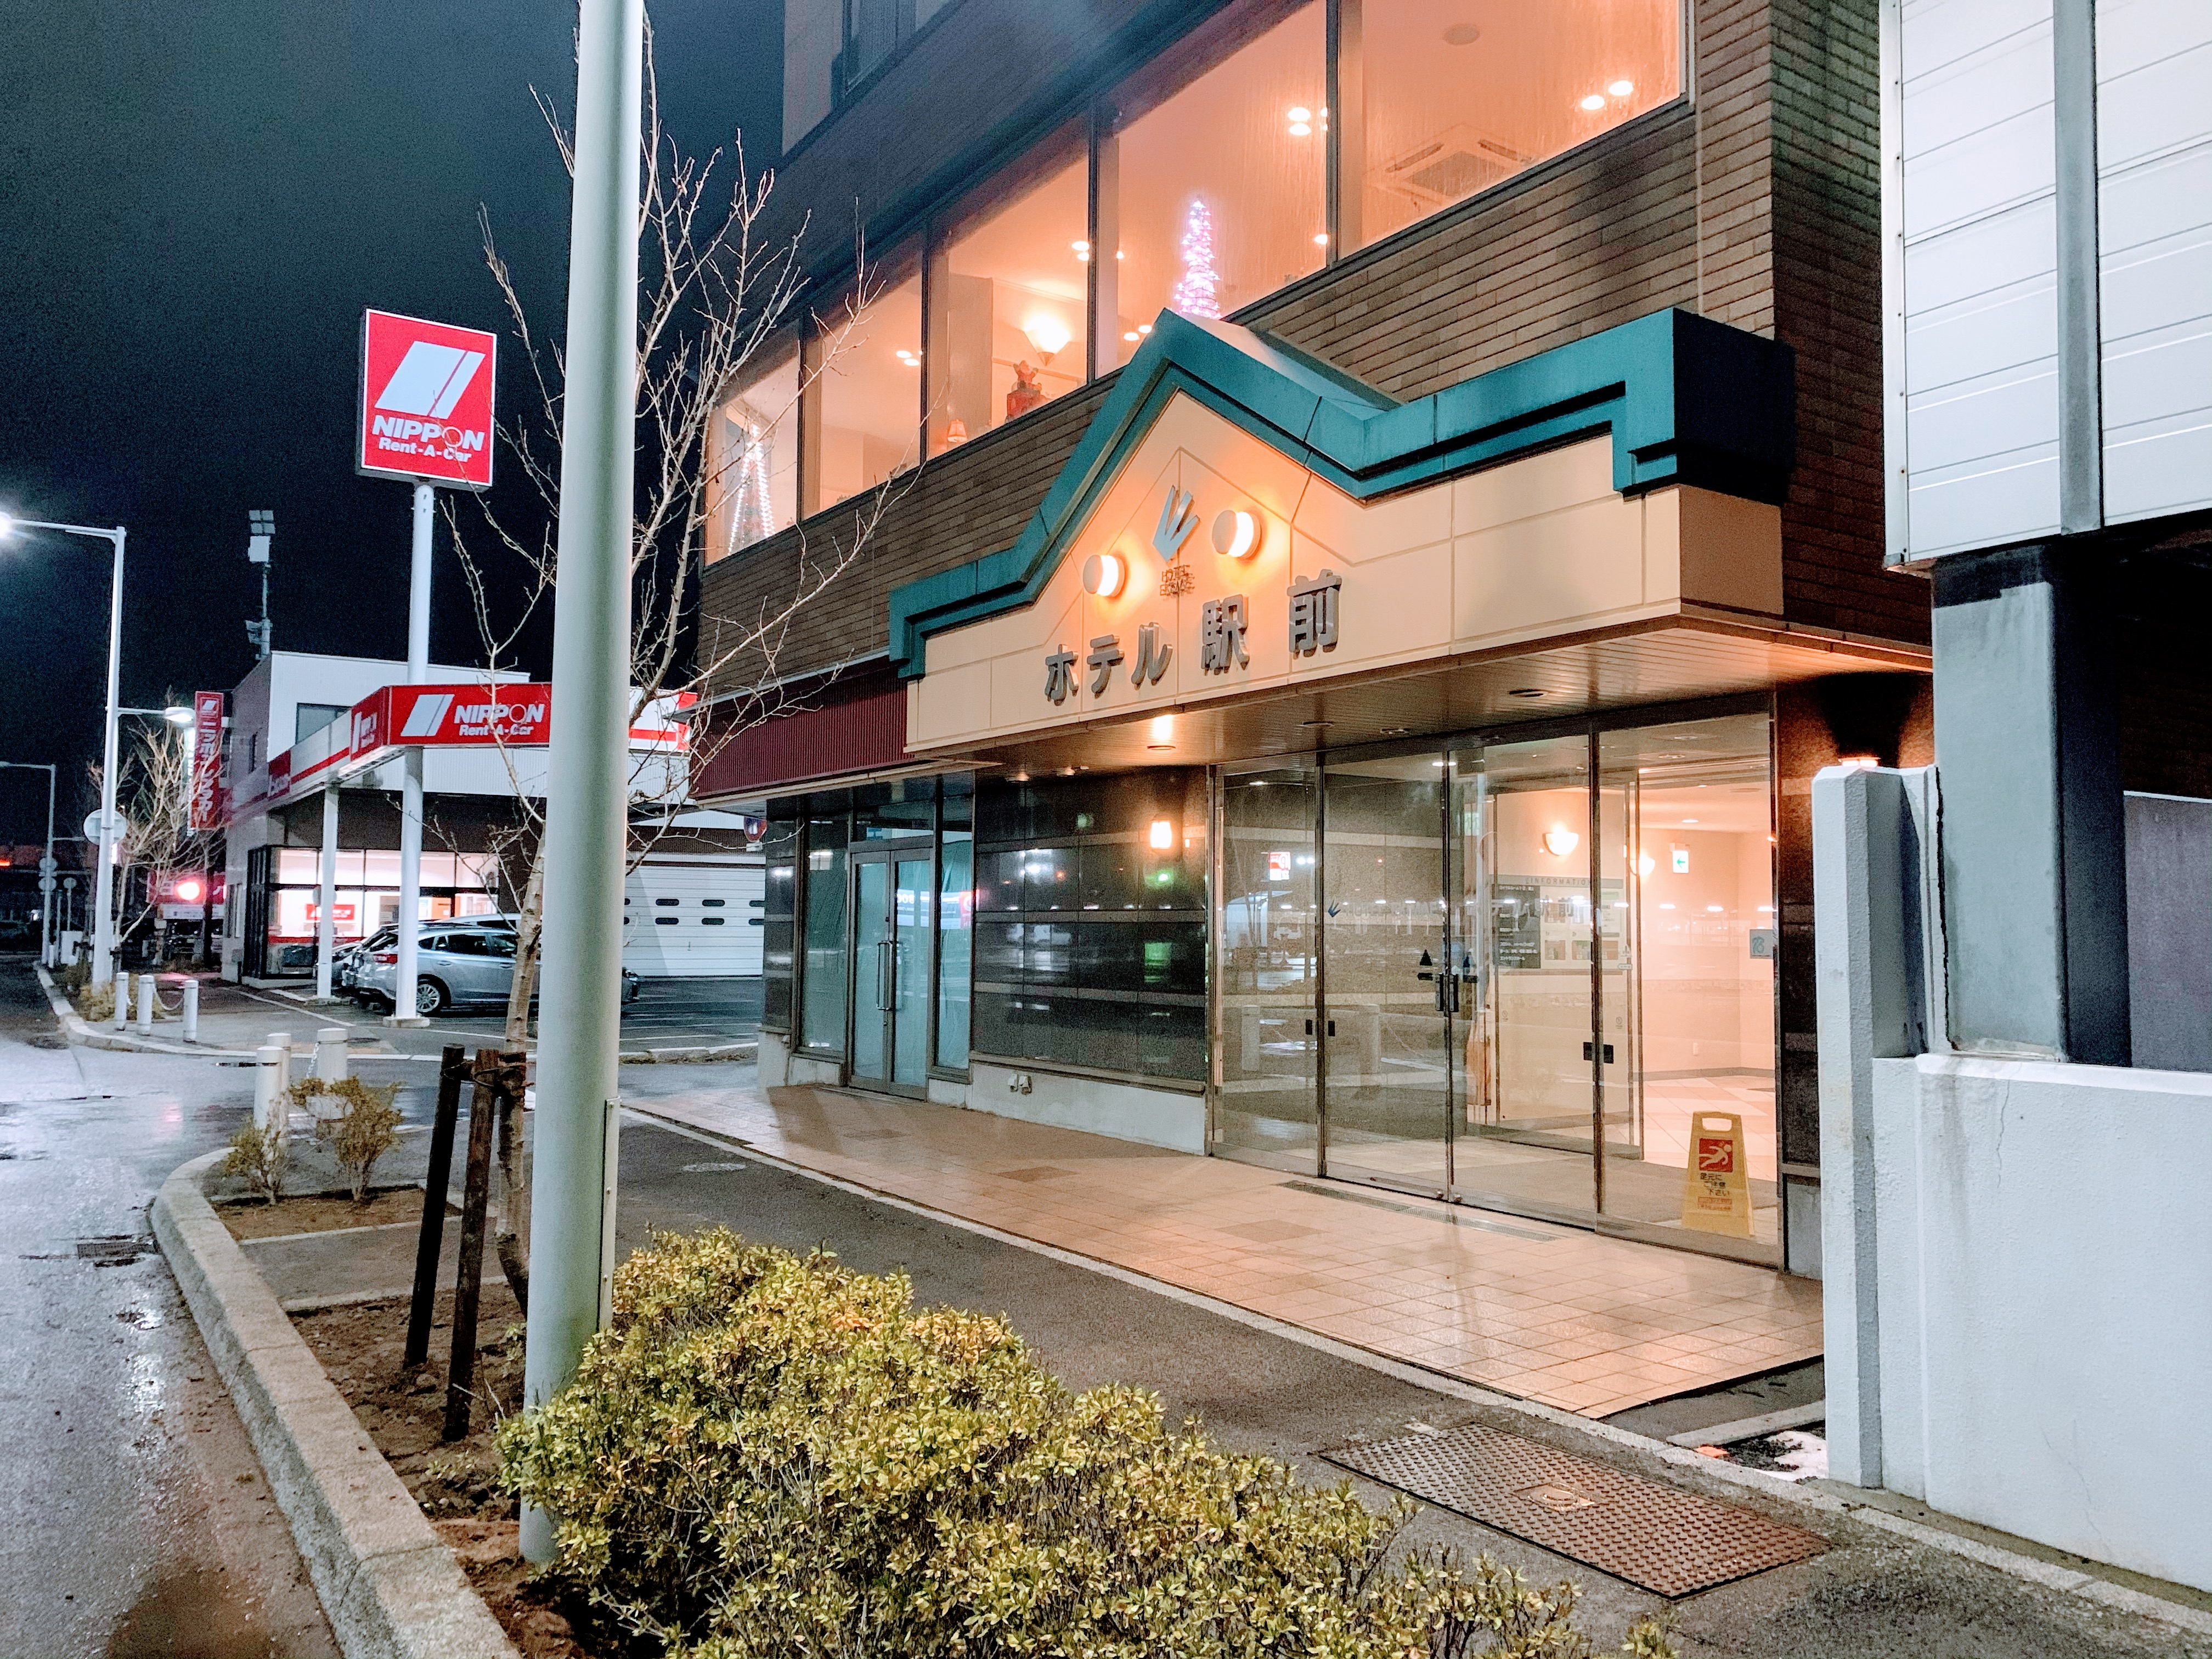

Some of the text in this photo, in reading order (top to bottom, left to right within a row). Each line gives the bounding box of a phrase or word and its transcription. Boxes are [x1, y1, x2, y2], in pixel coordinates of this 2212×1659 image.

[372, 415, 486, 452] NIPPON
[378, 437, 472, 462] Rent-A-Car
[1044, 568, 1342, 706] ホテル駅前
[454, 703, 545, 724] NIPPON
[459, 724, 534, 736] RentA-Car
